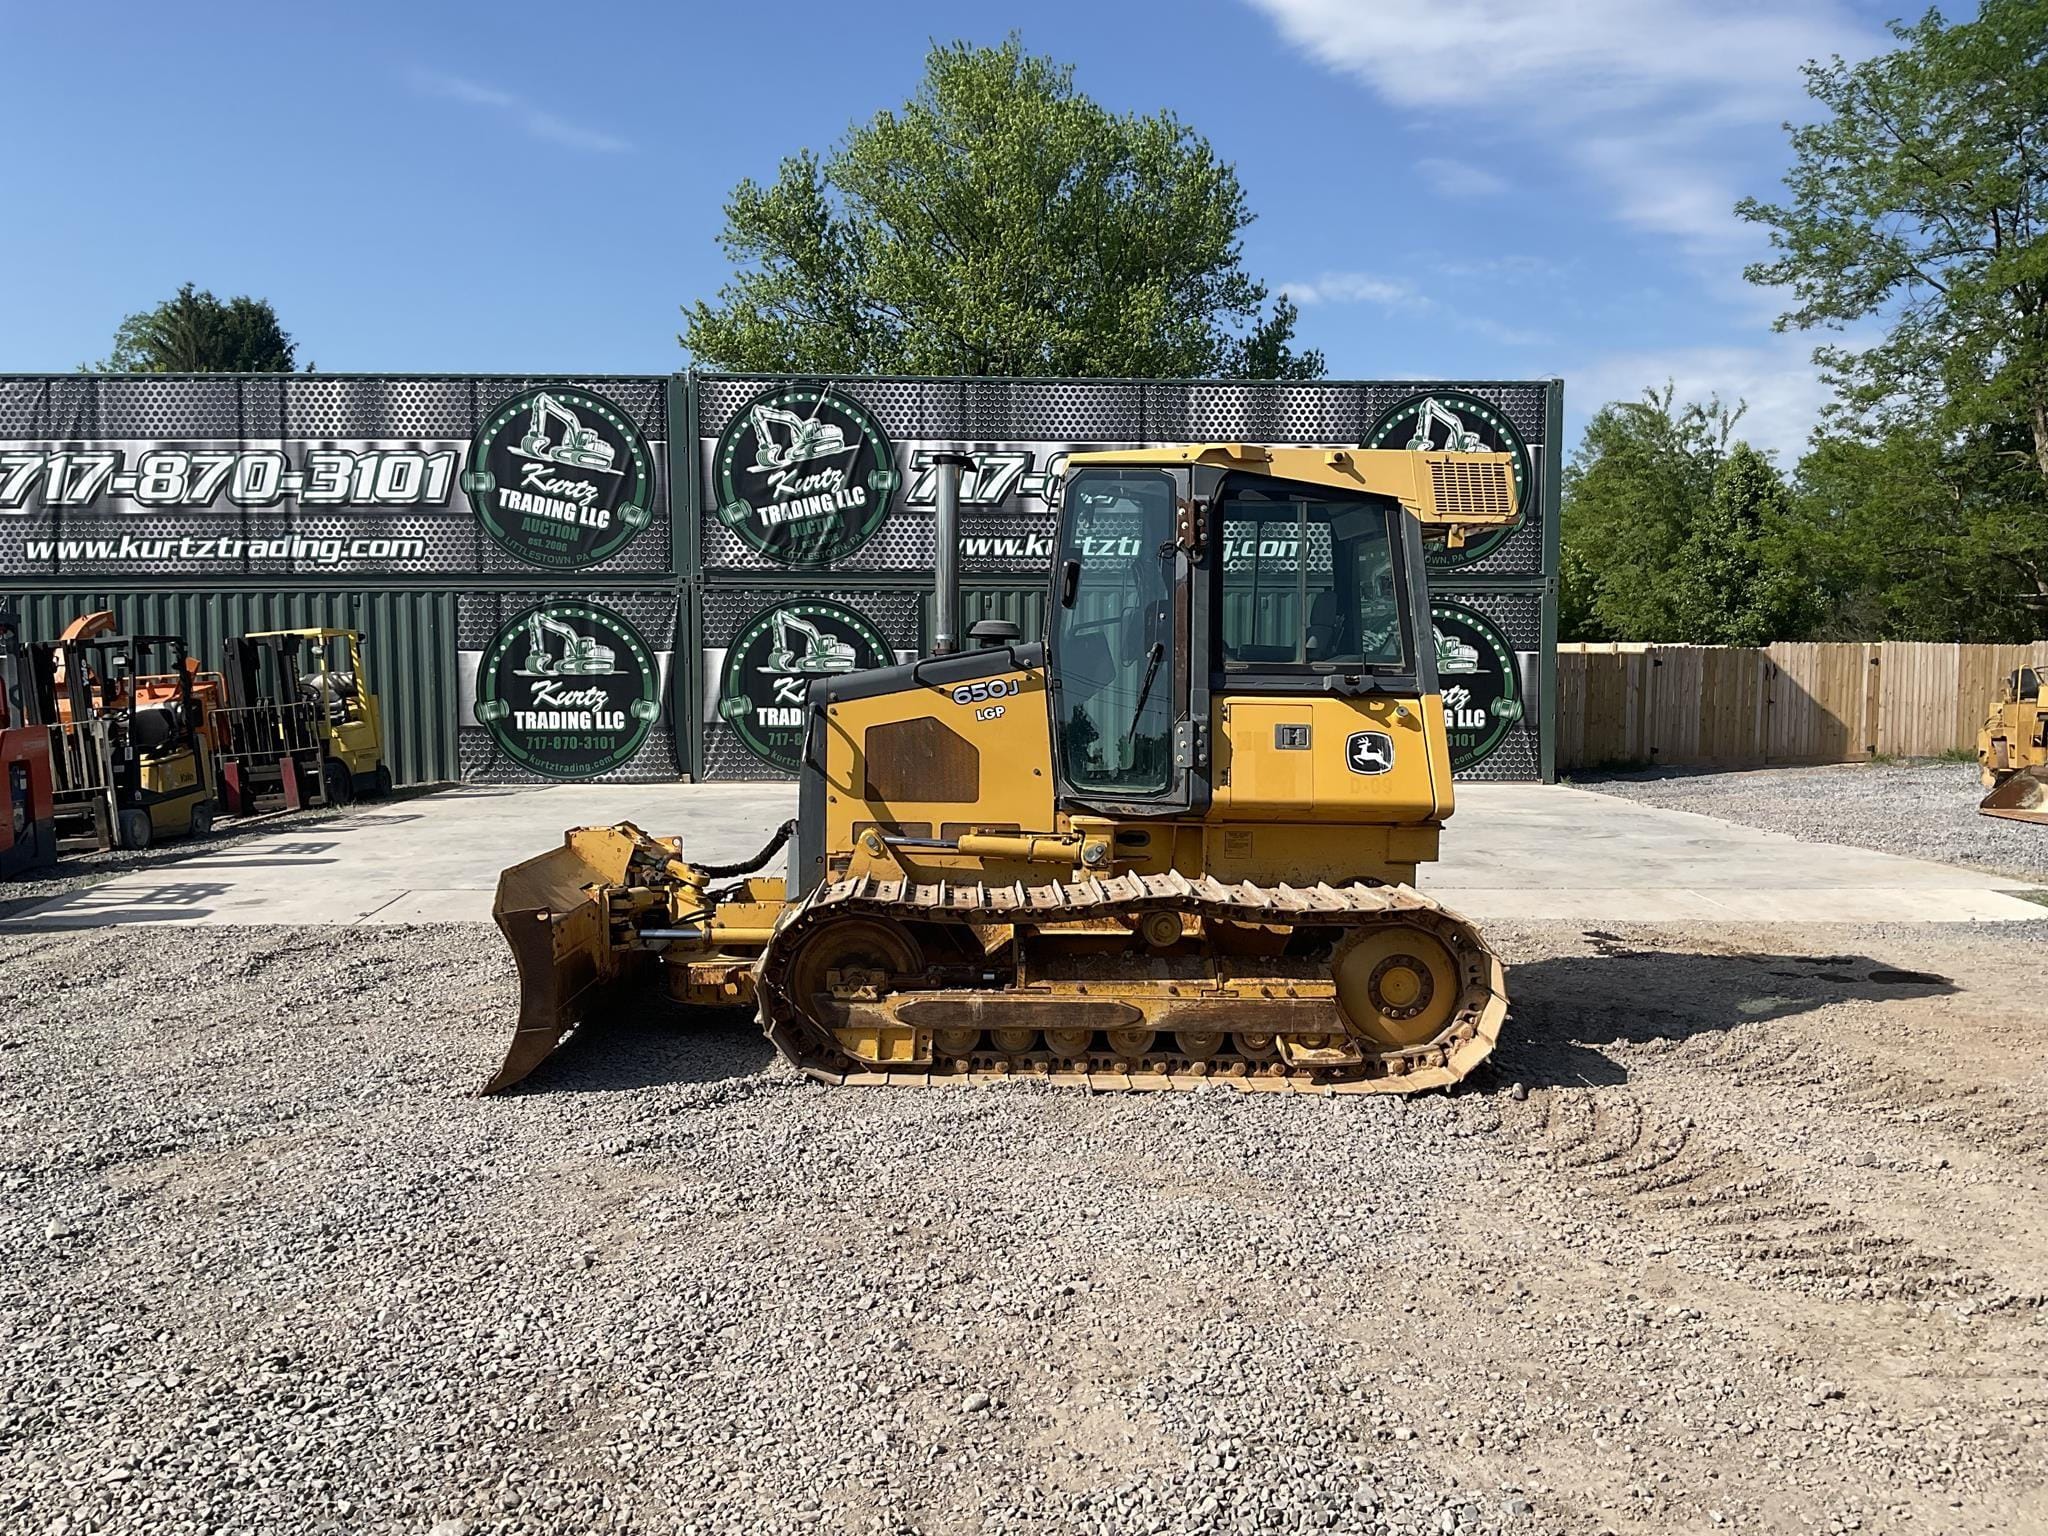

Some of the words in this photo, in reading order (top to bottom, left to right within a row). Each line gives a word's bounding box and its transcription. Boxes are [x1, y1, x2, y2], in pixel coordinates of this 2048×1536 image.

[0, 453, 455, 506] 717-870-3101
[521, 463, 599, 506] Kurtz
[767, 466, 845, 499] Kurtz
[499, 488, 577, 523] TRADING
[579, 505, 611, 529] LLC
[757, 493, 834, 526] TRADING
[835, 486, 866, 509] LLC
[521, 518, 580, 542] AUCTION
[789, 514, 844, 538] AUCTION
[26, 535, 424, 563] www.kurtztrading.com
[504, 536, 575, 565] LITTLESTOWN,
[576, 552, 590, 563] PA
[530, 680, 609, 713] Kurtz
[952, 679, 1020, 705] 650J
[513, 711, 592, 731] TRADING
[595, 711, 626, 731] LLC
[975, 705, 1006, 721] LGP
[1457, 708, 1486, 728] LLC
[526, 736, 616, 750] 717-870-3101
[528, 753, 613, 773] kurtztrading.com
